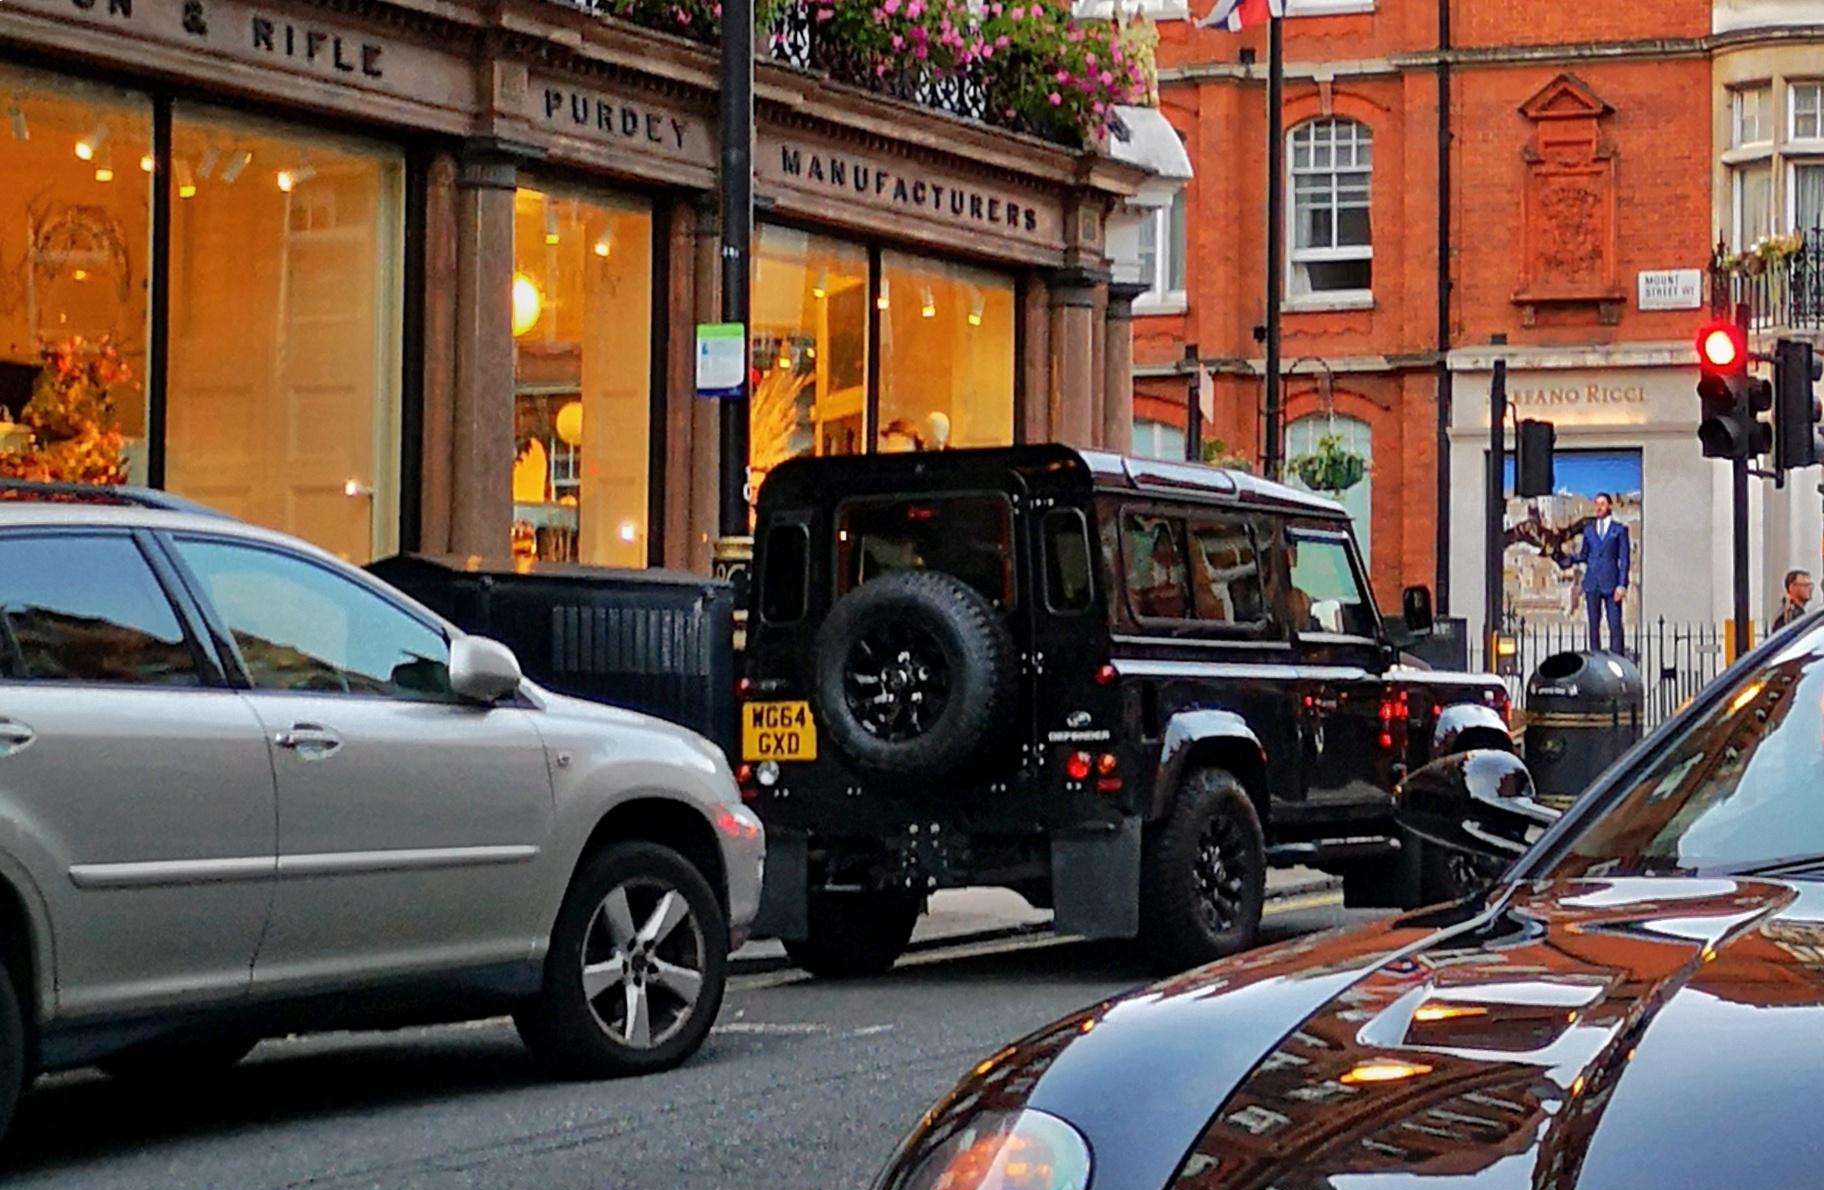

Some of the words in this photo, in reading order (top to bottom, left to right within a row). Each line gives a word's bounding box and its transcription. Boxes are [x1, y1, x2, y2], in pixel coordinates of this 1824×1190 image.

[253, 16, 383, 77] RIFLE
[544, 88, 688, 149] PURDEY
[781, 145, 1038, 231] MANUFACTURERS
[1645, 274, 1679, 285] MOUNT
[1645, 287, 1678, 297] STREET
[1586, 384, 1644, 404] RICCI
[752, 704, 806, 729] WG64
[758, 732, 800, 756] GXD
